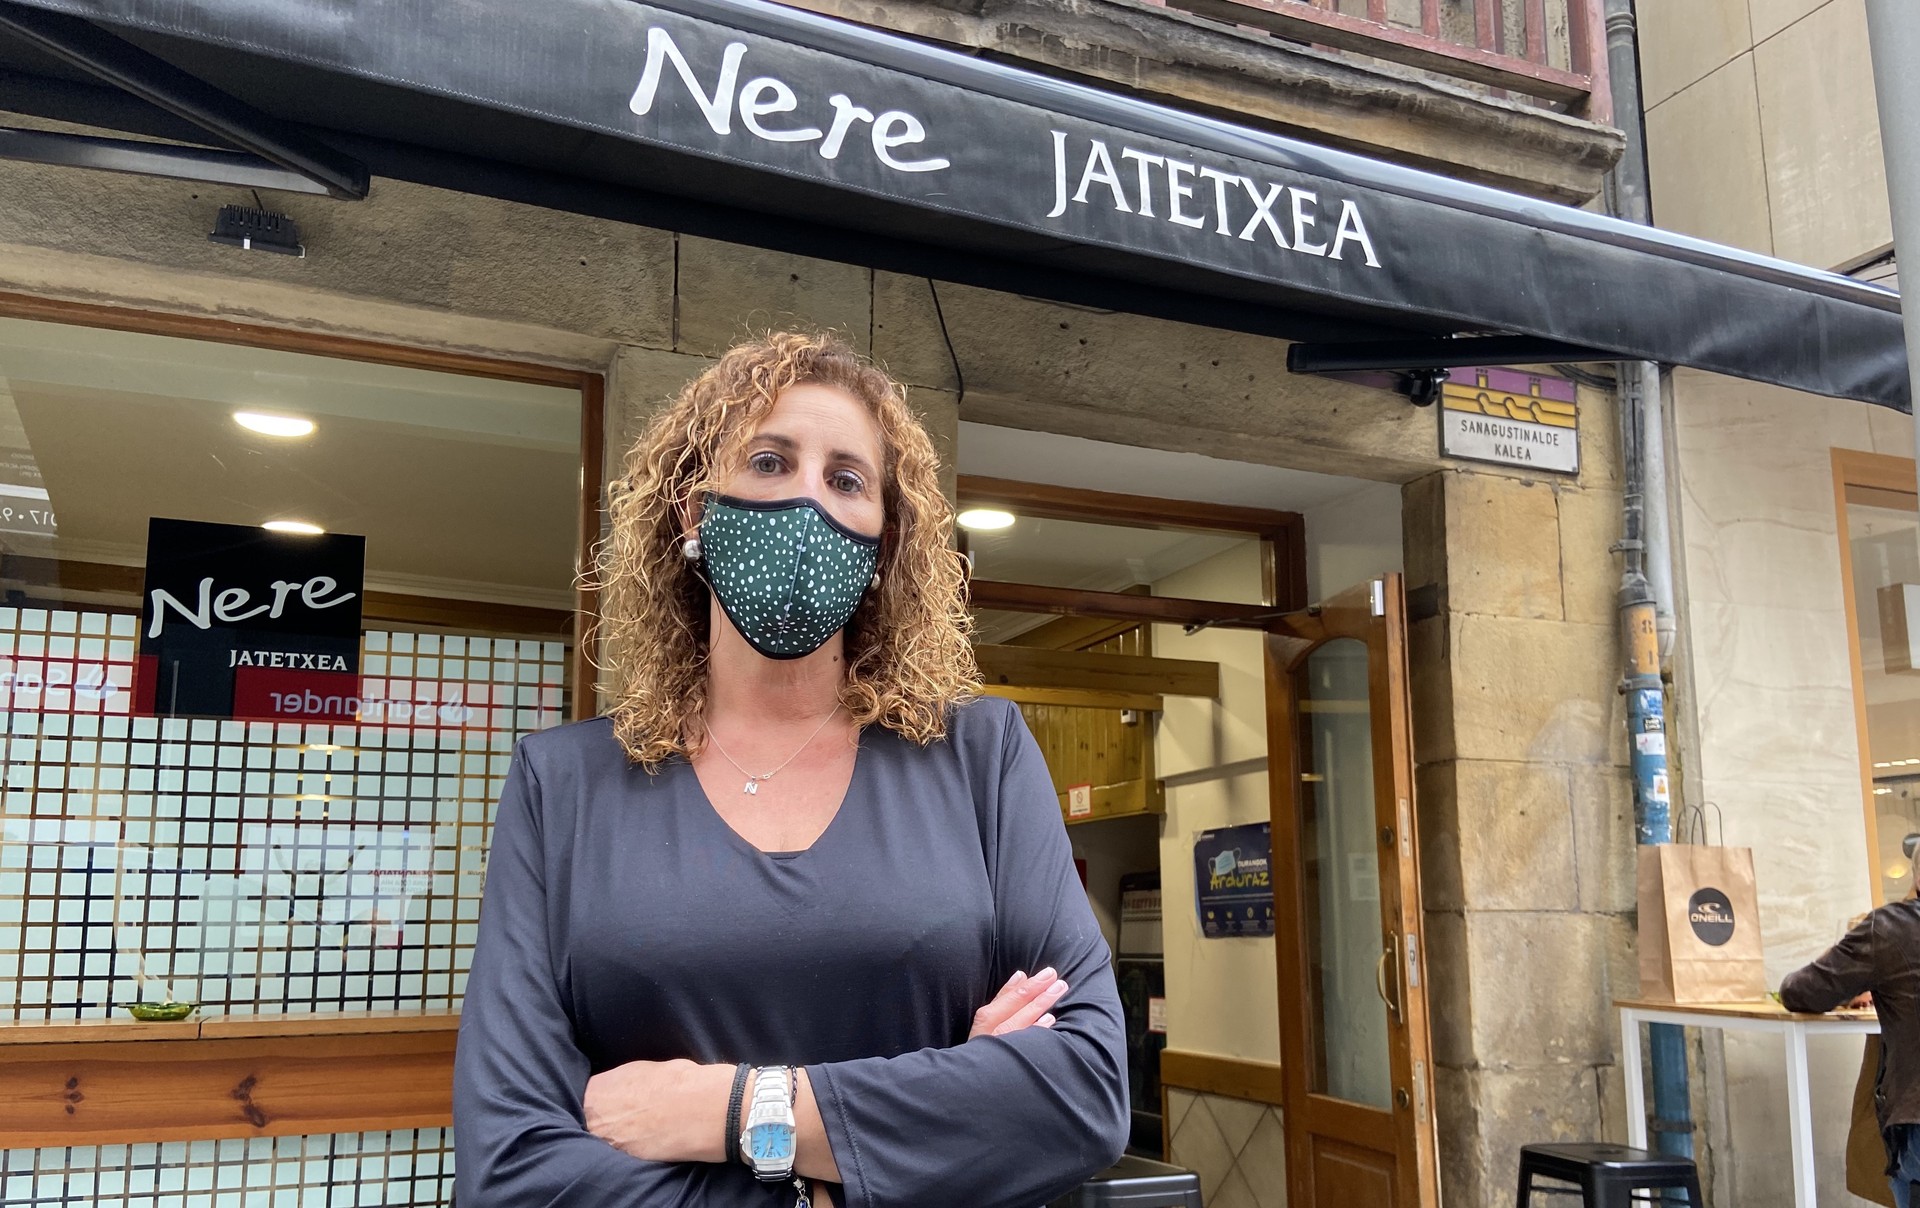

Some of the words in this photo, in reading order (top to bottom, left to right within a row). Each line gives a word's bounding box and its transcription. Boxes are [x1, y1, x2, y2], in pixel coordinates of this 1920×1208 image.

[629, 26, 951, 173] Nere
[1046, 129, 1383, 270] JATETXEA
[1461, 419, 1559, 446] SANAGUSTINALDE
[1494, 443, 1532, 461] KALEA
[148, 576, 357, 639] Nere
[229, 649, 348, 671] JATETXEA
